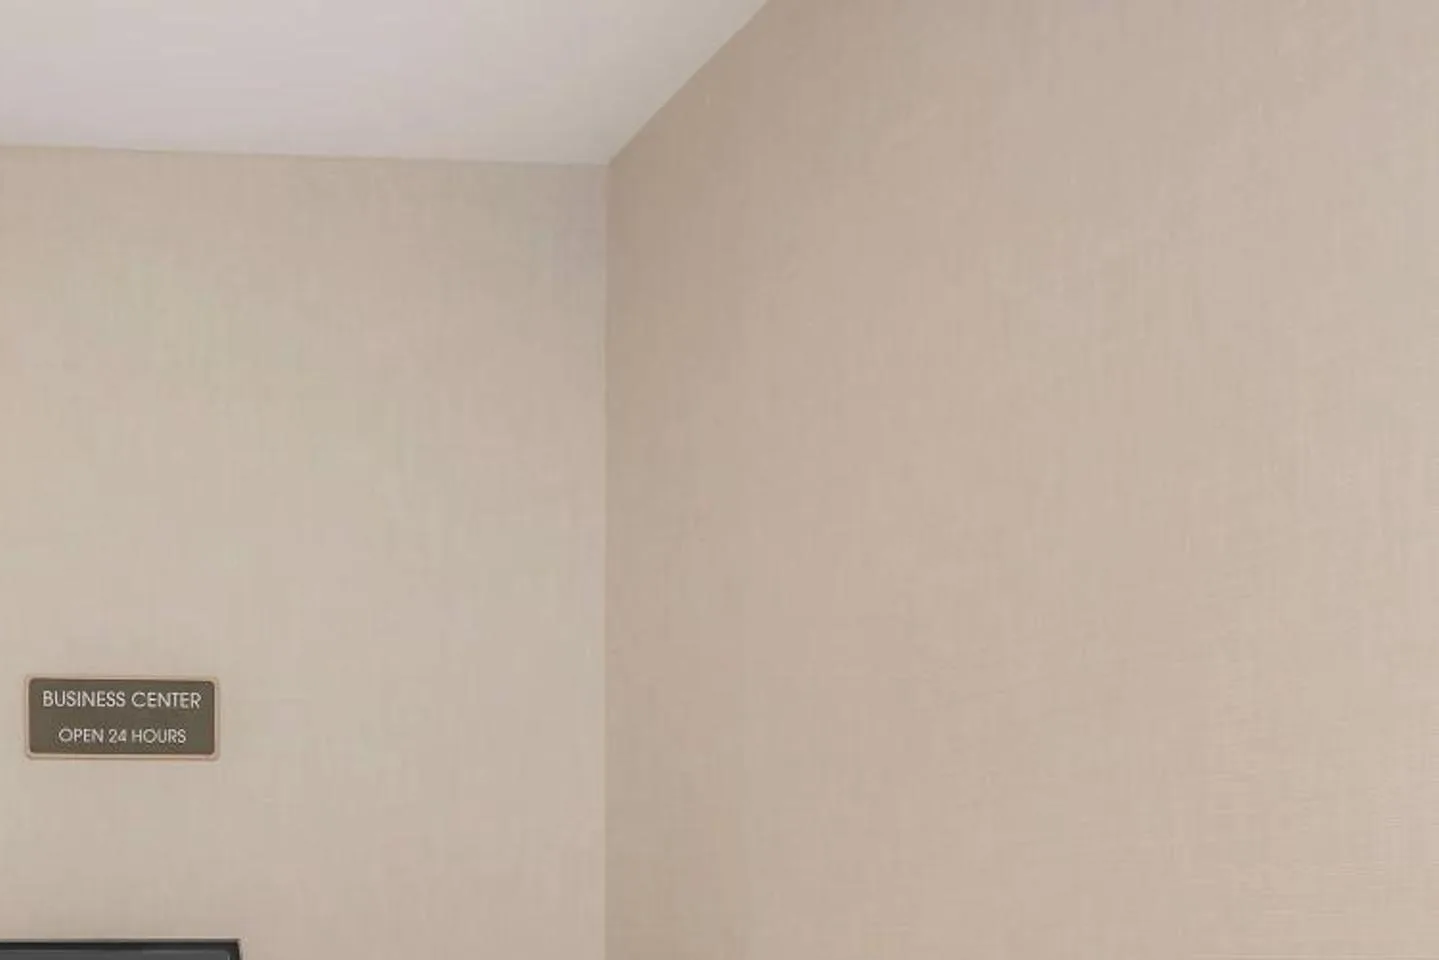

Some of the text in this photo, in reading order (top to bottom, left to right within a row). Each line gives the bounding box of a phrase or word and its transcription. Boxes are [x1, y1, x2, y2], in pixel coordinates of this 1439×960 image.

[42, 690, 202, 709] BUSINESS CENTER
[59, 728, 186, 744] OPEN 24 HOURS
